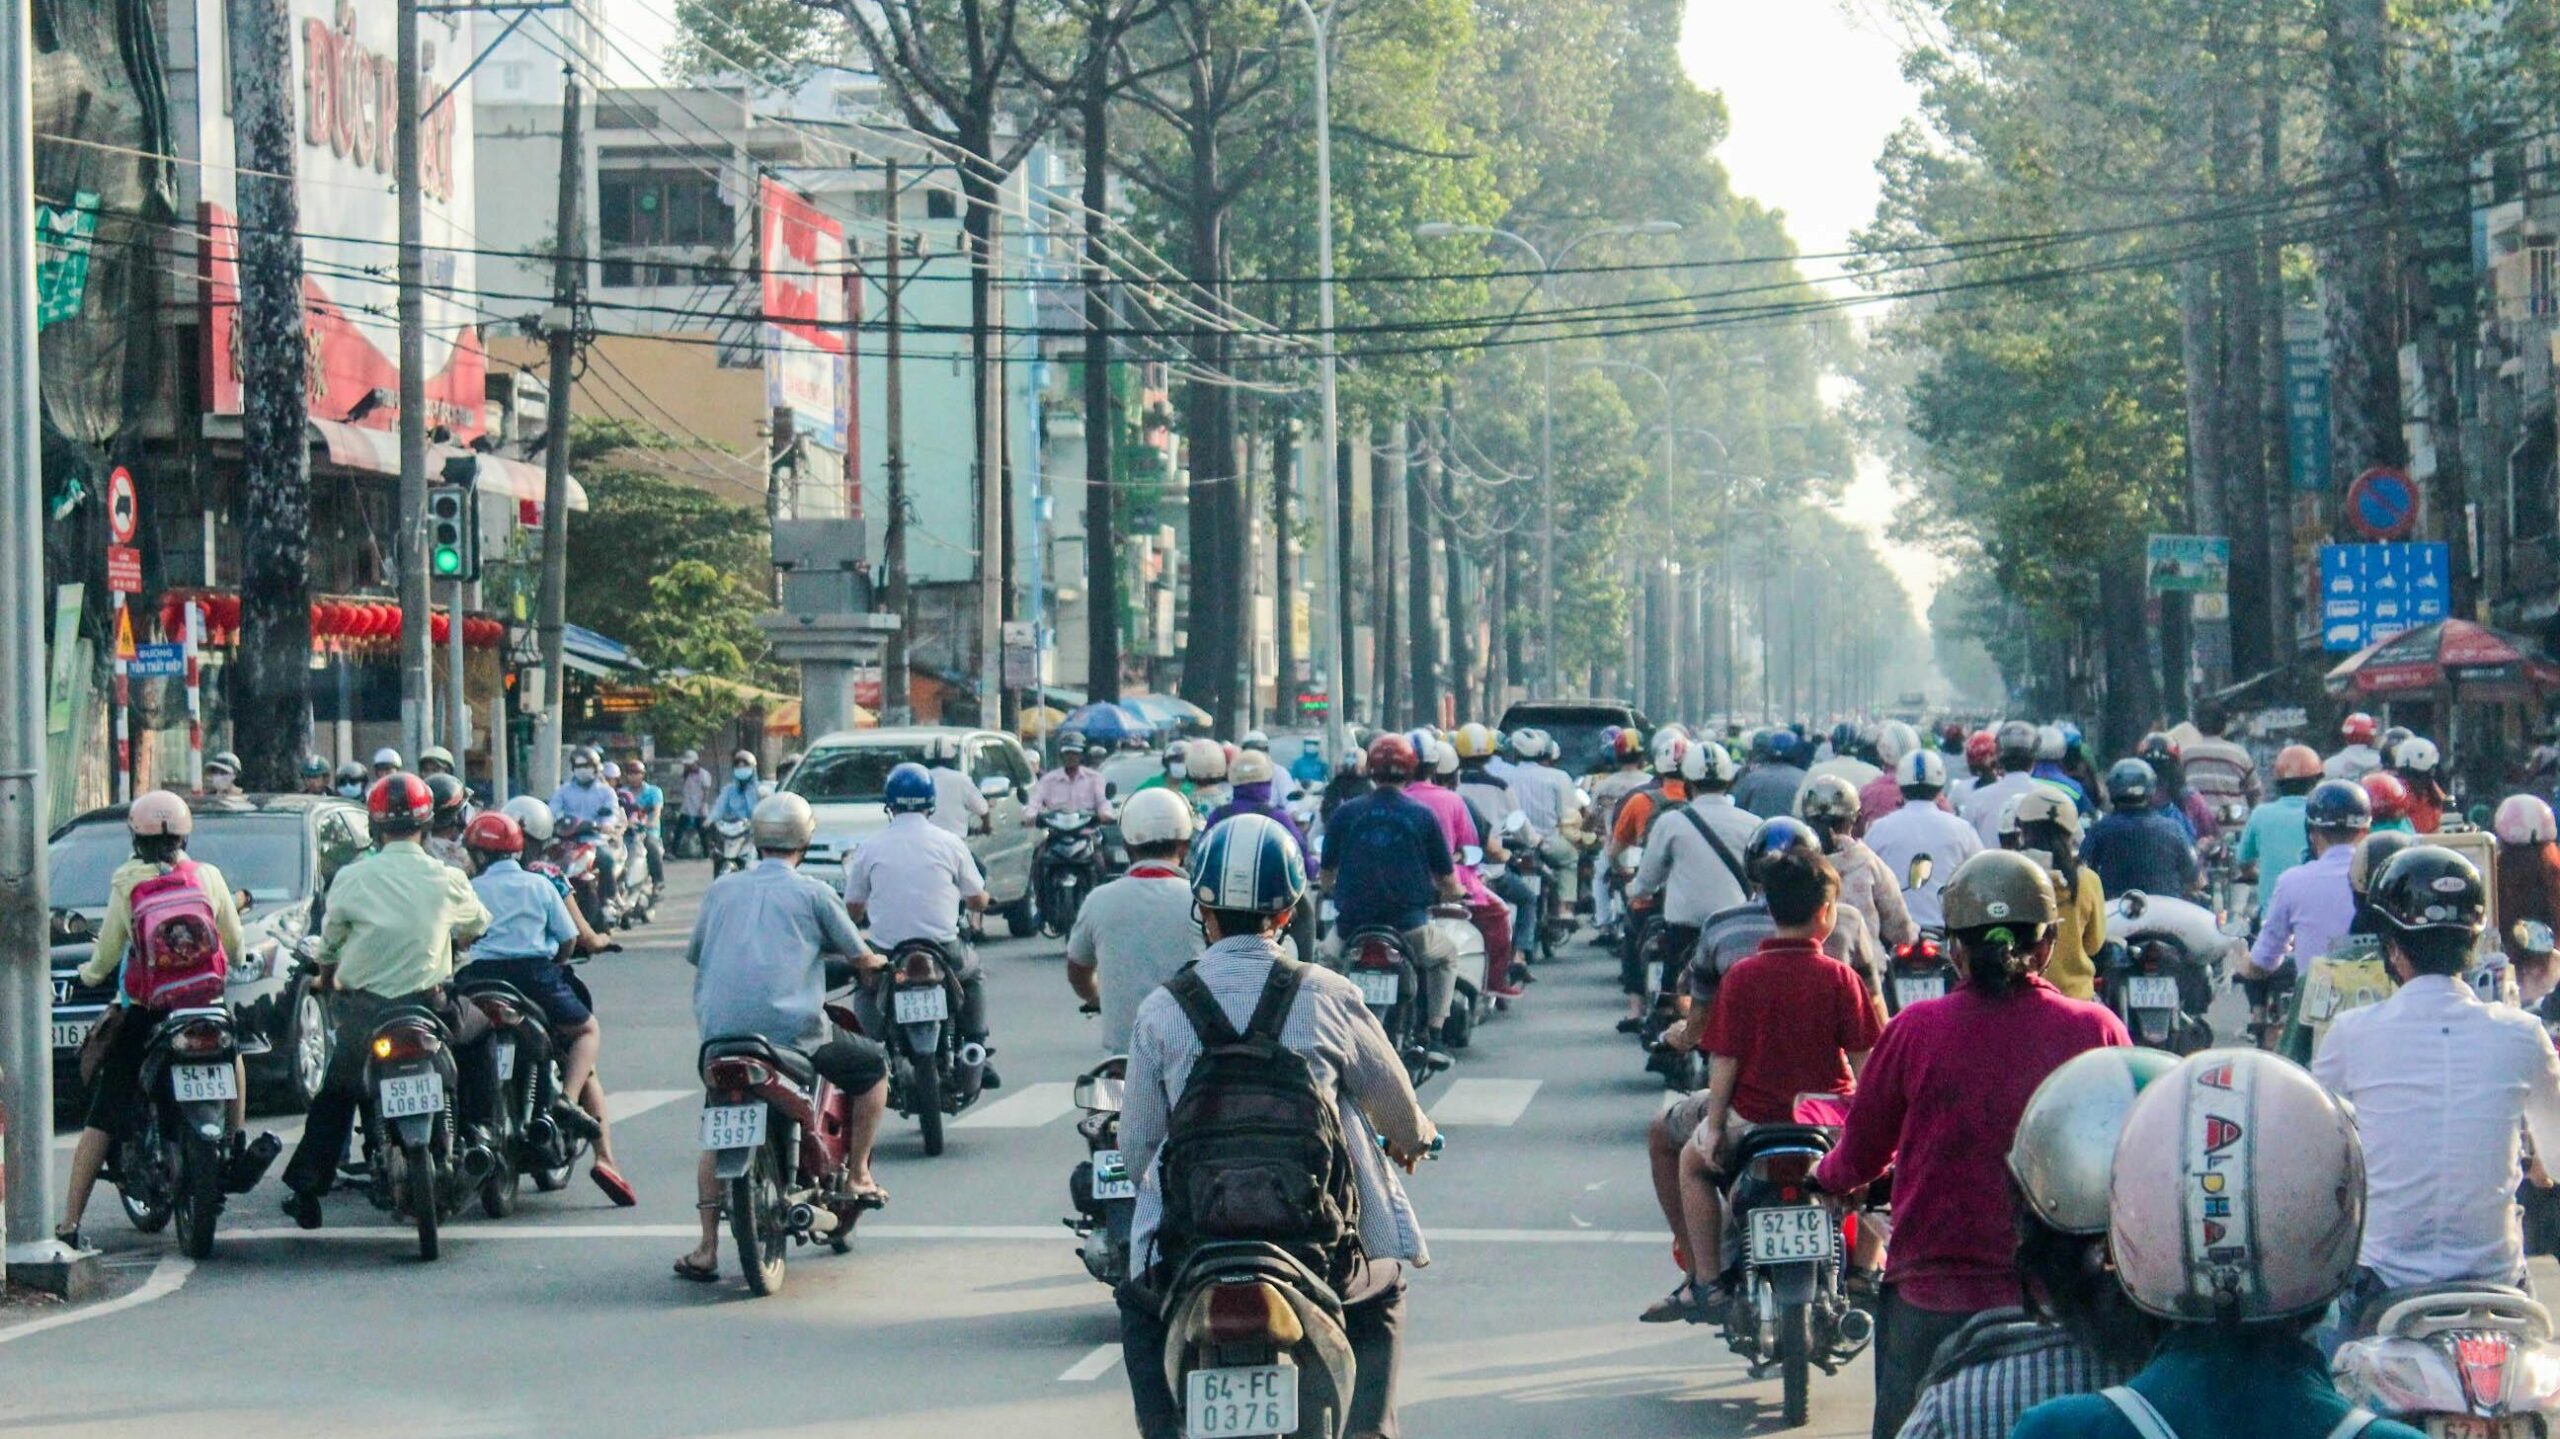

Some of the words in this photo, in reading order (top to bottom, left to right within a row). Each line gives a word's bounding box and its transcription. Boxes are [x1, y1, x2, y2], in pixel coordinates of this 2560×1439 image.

[374, 39, 457, 205] PÁT
[183, 1082, 227, 1098] 9055
[390, 1078, 431, 1097] 59-H1
[712, 1126, 756, 1146] 5997
[1762, 1210, 1818, 1234] 52-KC
[1765, 1234, 1820, 1257] 8455
[1204, 1371, 1279, 1401] 64-FC
[1204, 1402, 1280, 1432] 0376
